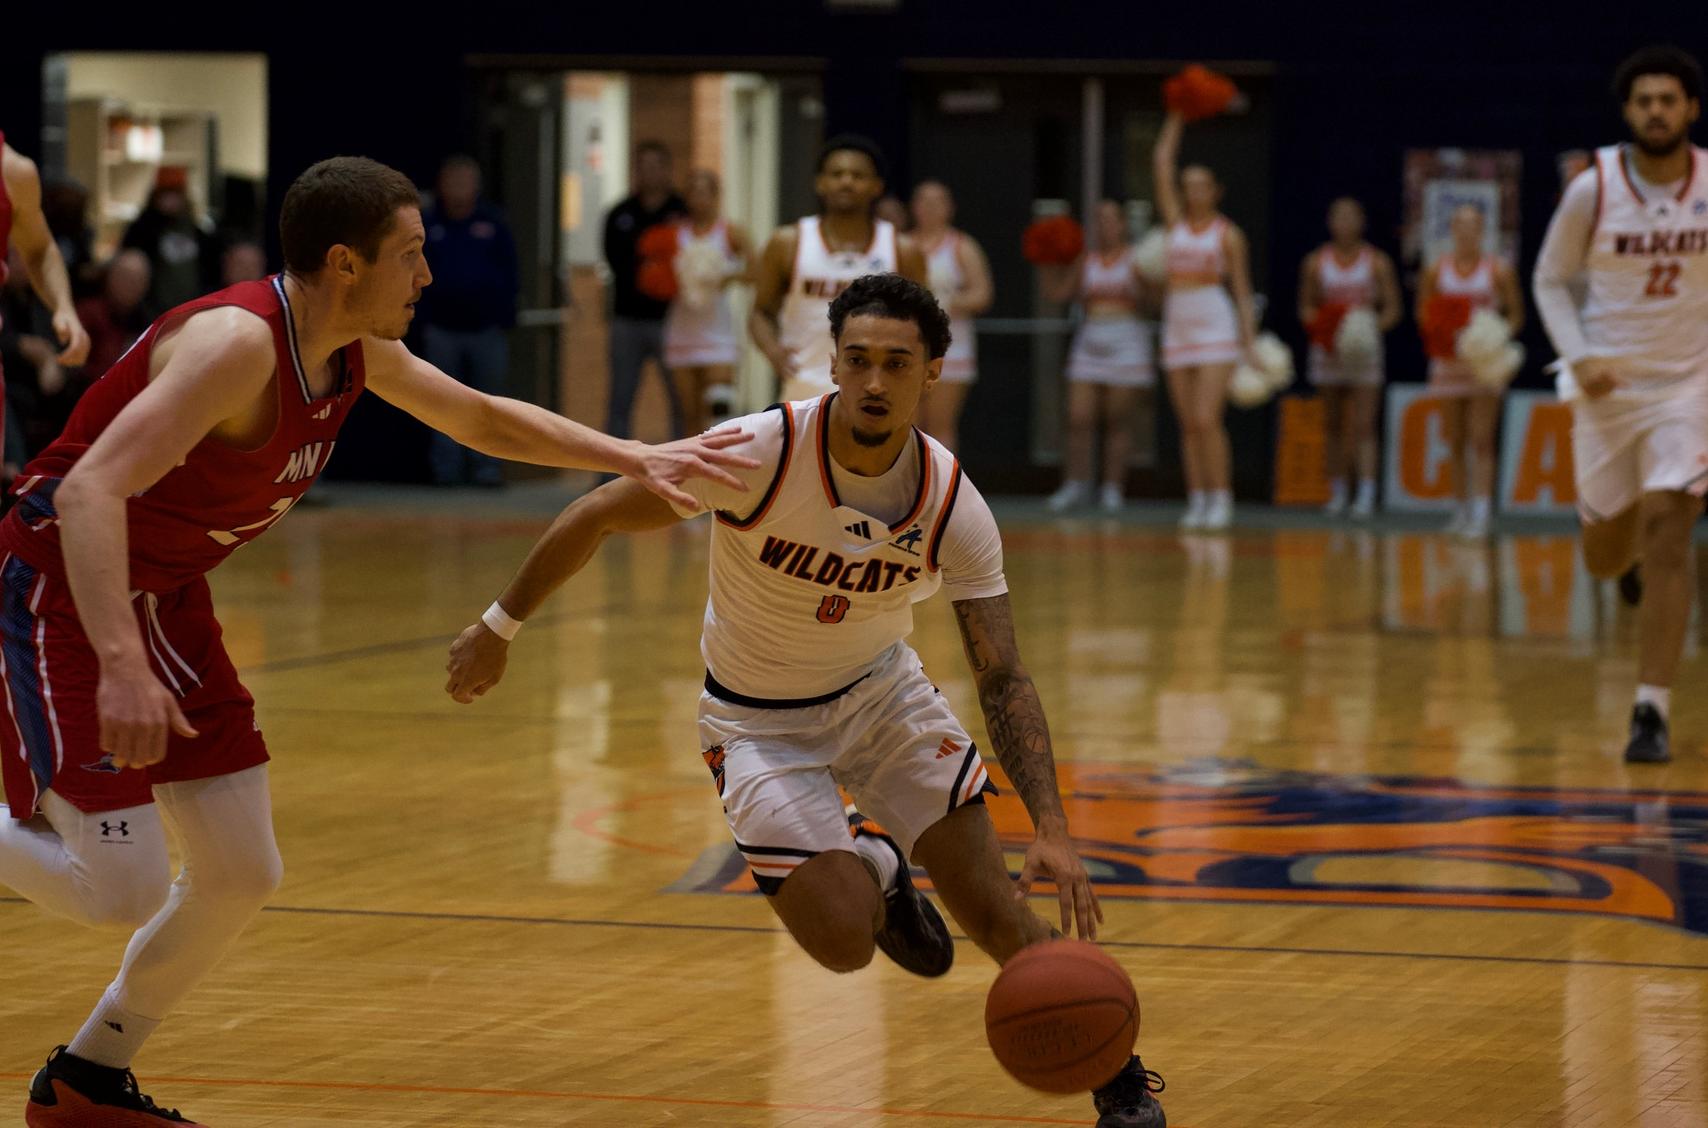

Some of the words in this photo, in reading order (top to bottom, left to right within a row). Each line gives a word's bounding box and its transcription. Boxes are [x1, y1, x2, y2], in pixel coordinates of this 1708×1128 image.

[1644, 263, 1682, 298] 22
[274, 442, 322, 483] MN
[1511, 402, 1579, 504] A
[758, 535, 922, 593] WILDCATS
[816, 594, 850, 624] 0
